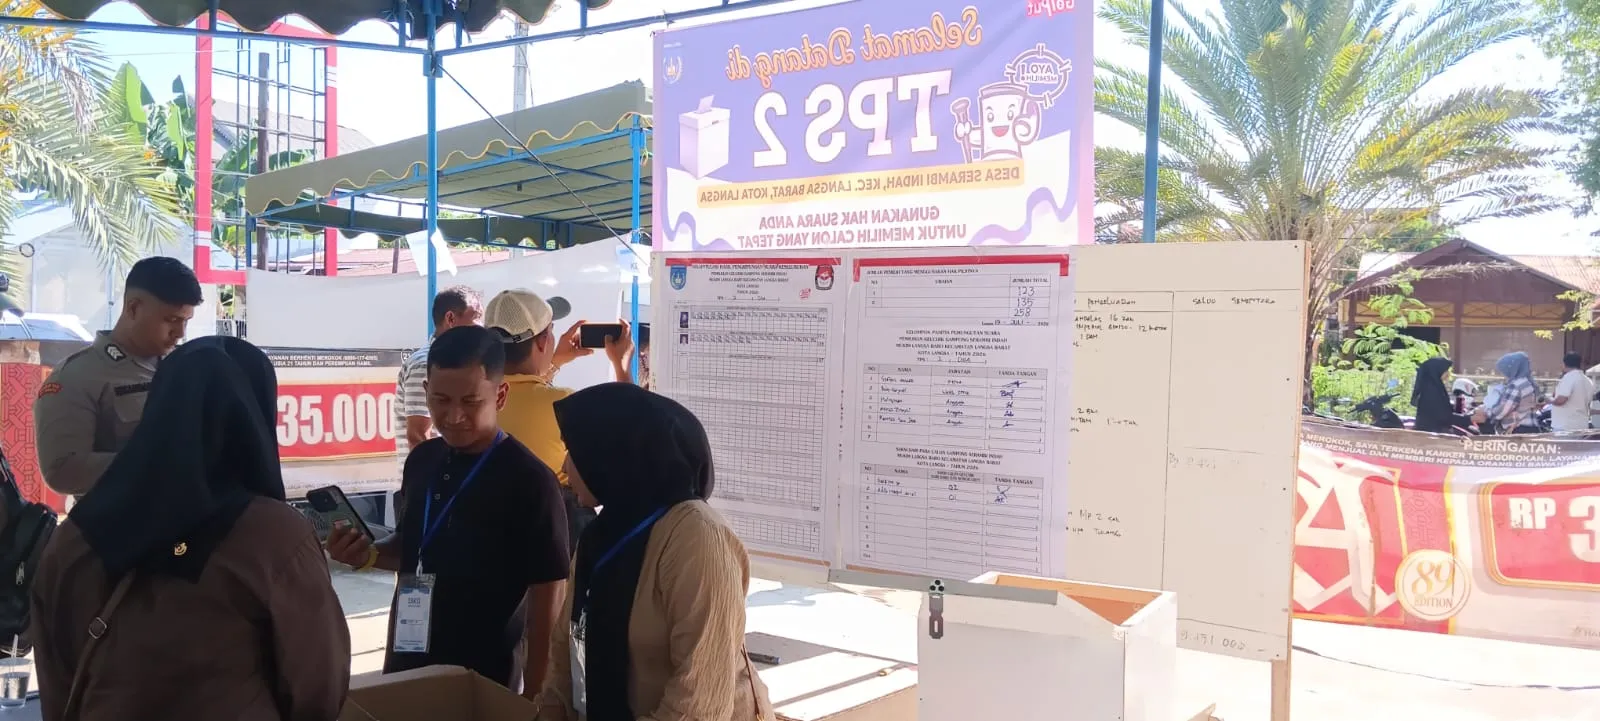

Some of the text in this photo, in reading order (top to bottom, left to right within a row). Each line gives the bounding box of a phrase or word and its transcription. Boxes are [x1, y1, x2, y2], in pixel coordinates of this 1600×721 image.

[1018, 286, 1035, 296] 123
[1017, 297, 1034, 307] 135
[1014, 307, 1031, 317] 258
[276, 392, 396, 447] 35.000
[1325, 444, 1368, 455] MENJUAL
[1390, 453, 1433, 463] MEMBERI
[1435, 456, 1478, 465] KEPADA
[1355, 441, 1379, 450] SAYA
[1381, 444, 1423, 455] TERKENA
[1425, 448, 1466, 458] KANKER
[1463, 440, 1561, 454] PERINGATAN:
[1508, 497, 1557, 530] RP
[1412, 560, 1454, 597] 89
[1414, 596, 1453, 608] EDITION
